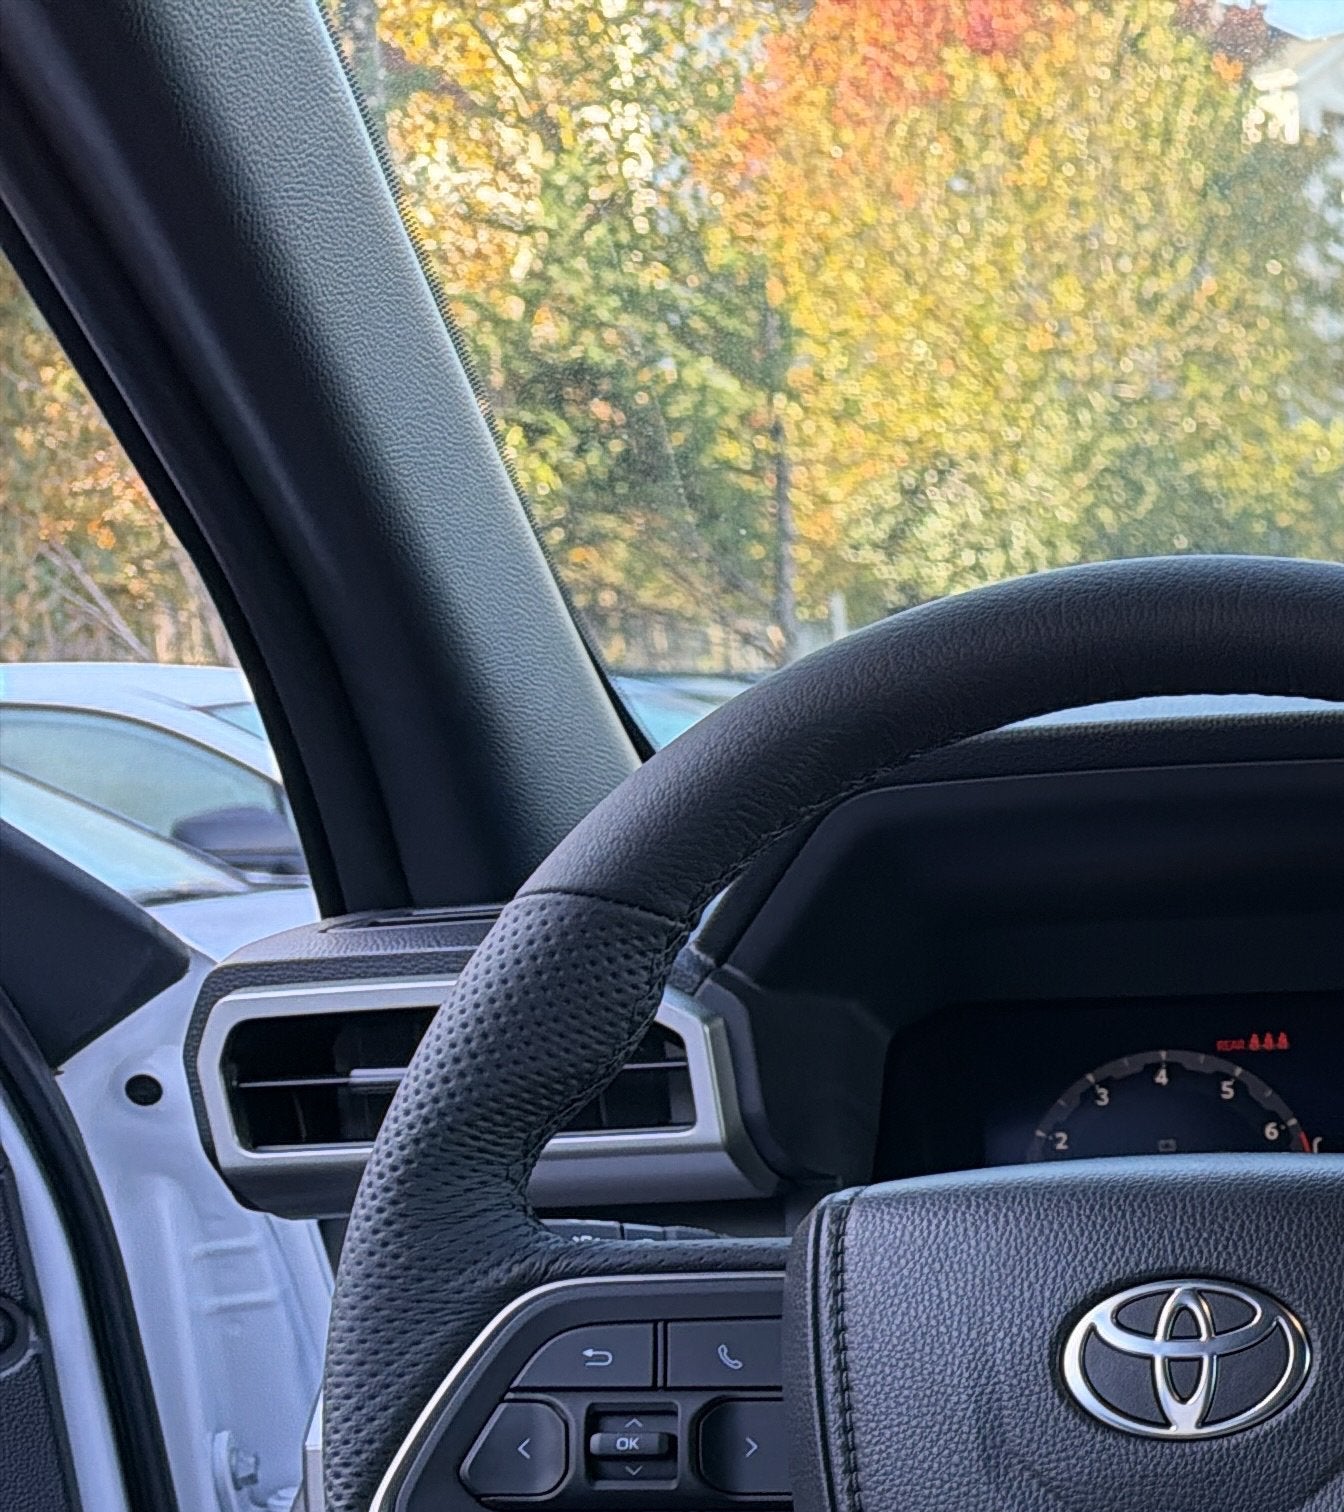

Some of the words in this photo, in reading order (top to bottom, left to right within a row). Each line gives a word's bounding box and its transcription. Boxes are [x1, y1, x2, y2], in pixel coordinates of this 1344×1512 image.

[1154, 1067, 1168, 1086] 4
[1094, 1086, 1110, 1106] 3
[1219, 1080, 1235, 1100] 5
[1054, 1131, 1069, 1150] 2
[1264, 1121, 1279, 1141] 6
[616, 1437, 640, 1452] OK
